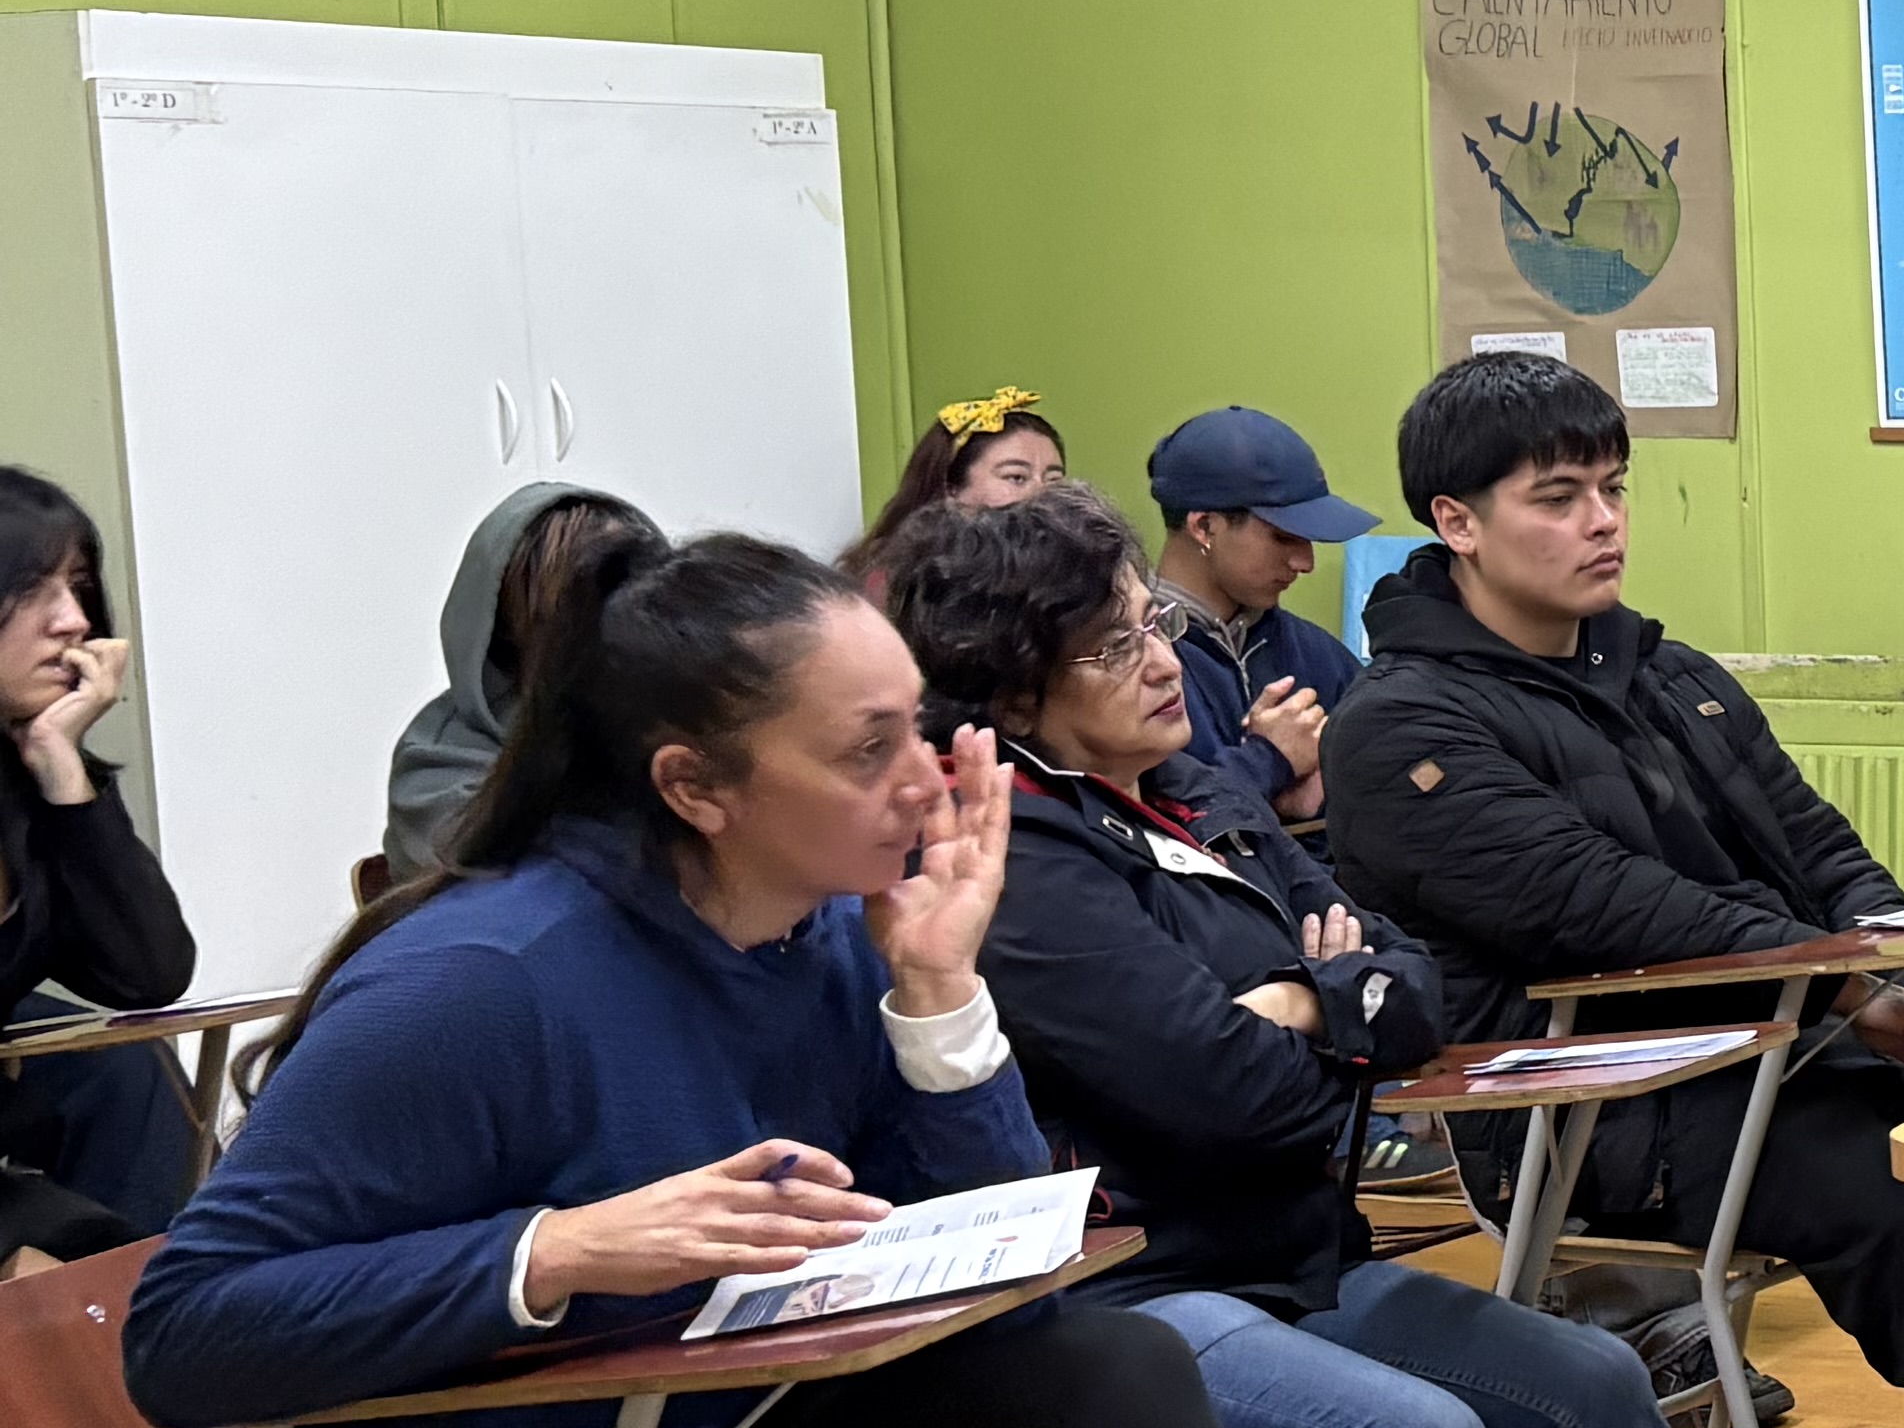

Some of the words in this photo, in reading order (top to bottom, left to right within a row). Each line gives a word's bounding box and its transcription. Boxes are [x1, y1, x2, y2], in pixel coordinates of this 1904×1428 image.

[1439, 19, 1542, 59] GLOBAL
[163, 93, 176, 108] D
[807, 122, 816, 134] A
